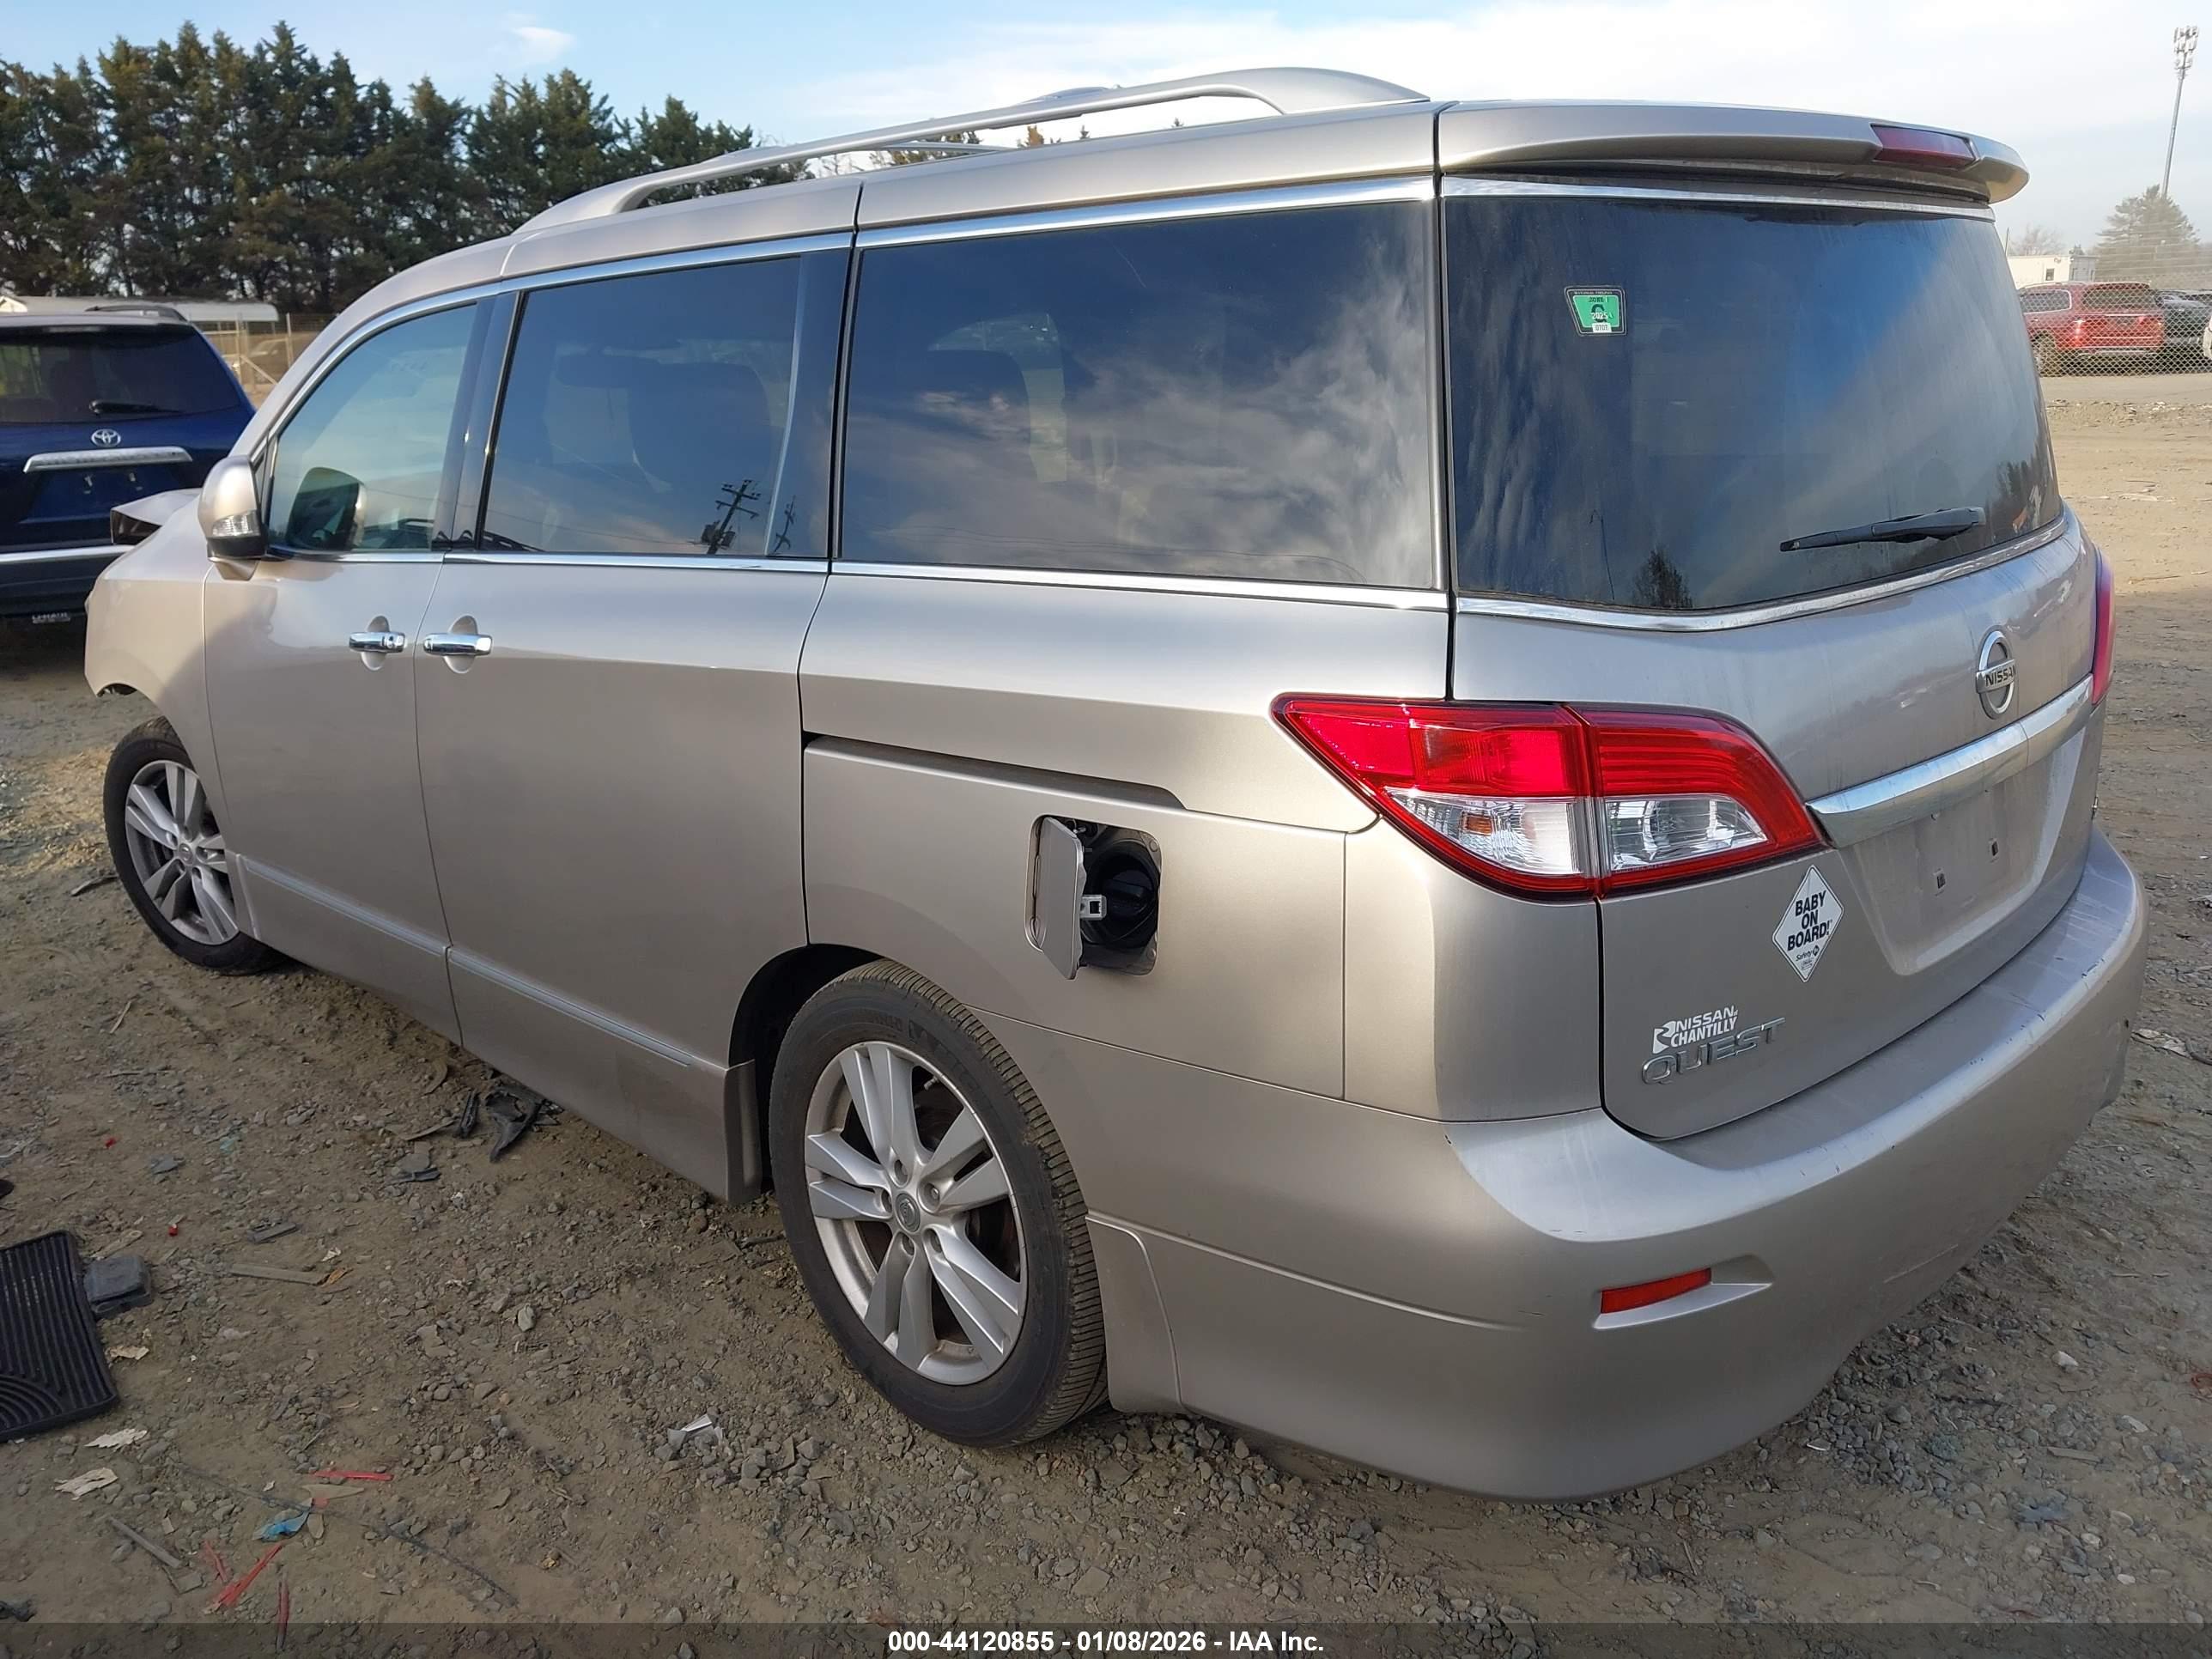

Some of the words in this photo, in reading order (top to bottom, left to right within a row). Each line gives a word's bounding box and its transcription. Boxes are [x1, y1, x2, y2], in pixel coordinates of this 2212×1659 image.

[1795, 890, 1827, 917] BABY
[1801, 910, 1819, 930] ON
[1670, 1016, 1738, 1048] CHANTILLY
[1675, 1005, 1735, 1033] NISSAN
[1641, 1017, 1786, 1085] QUEST
